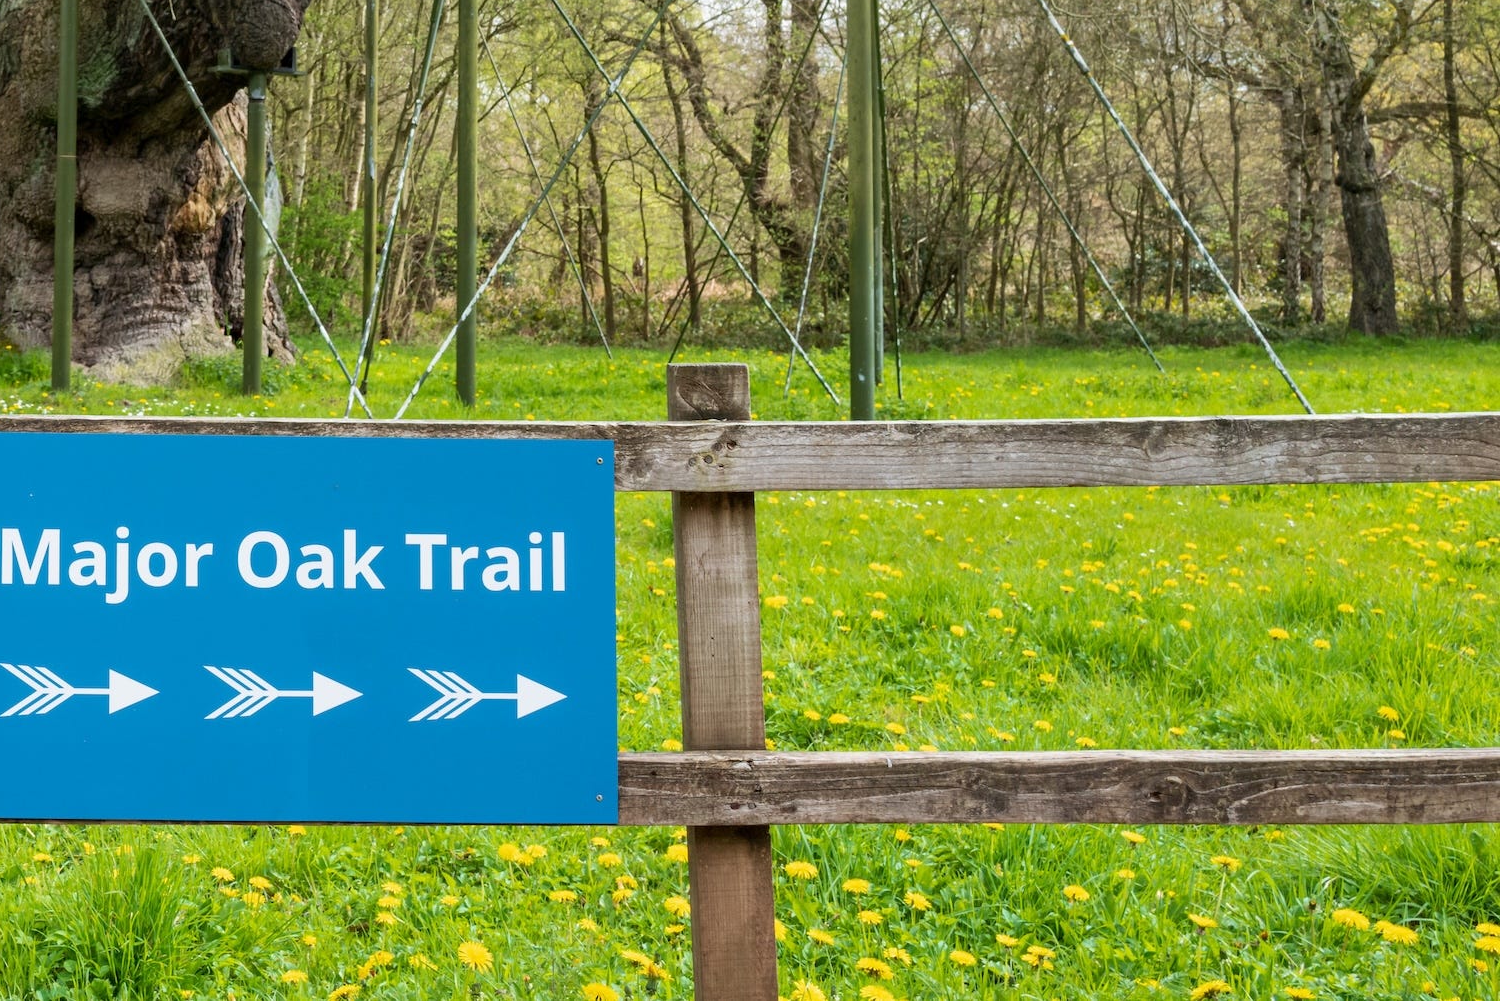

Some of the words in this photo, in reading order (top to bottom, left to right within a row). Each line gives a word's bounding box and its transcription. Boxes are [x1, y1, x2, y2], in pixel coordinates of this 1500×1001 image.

[0, 526, 214, 604] Major
[237, 529, 385, 590] Oak
[405, 531, 566, 592] Trail
